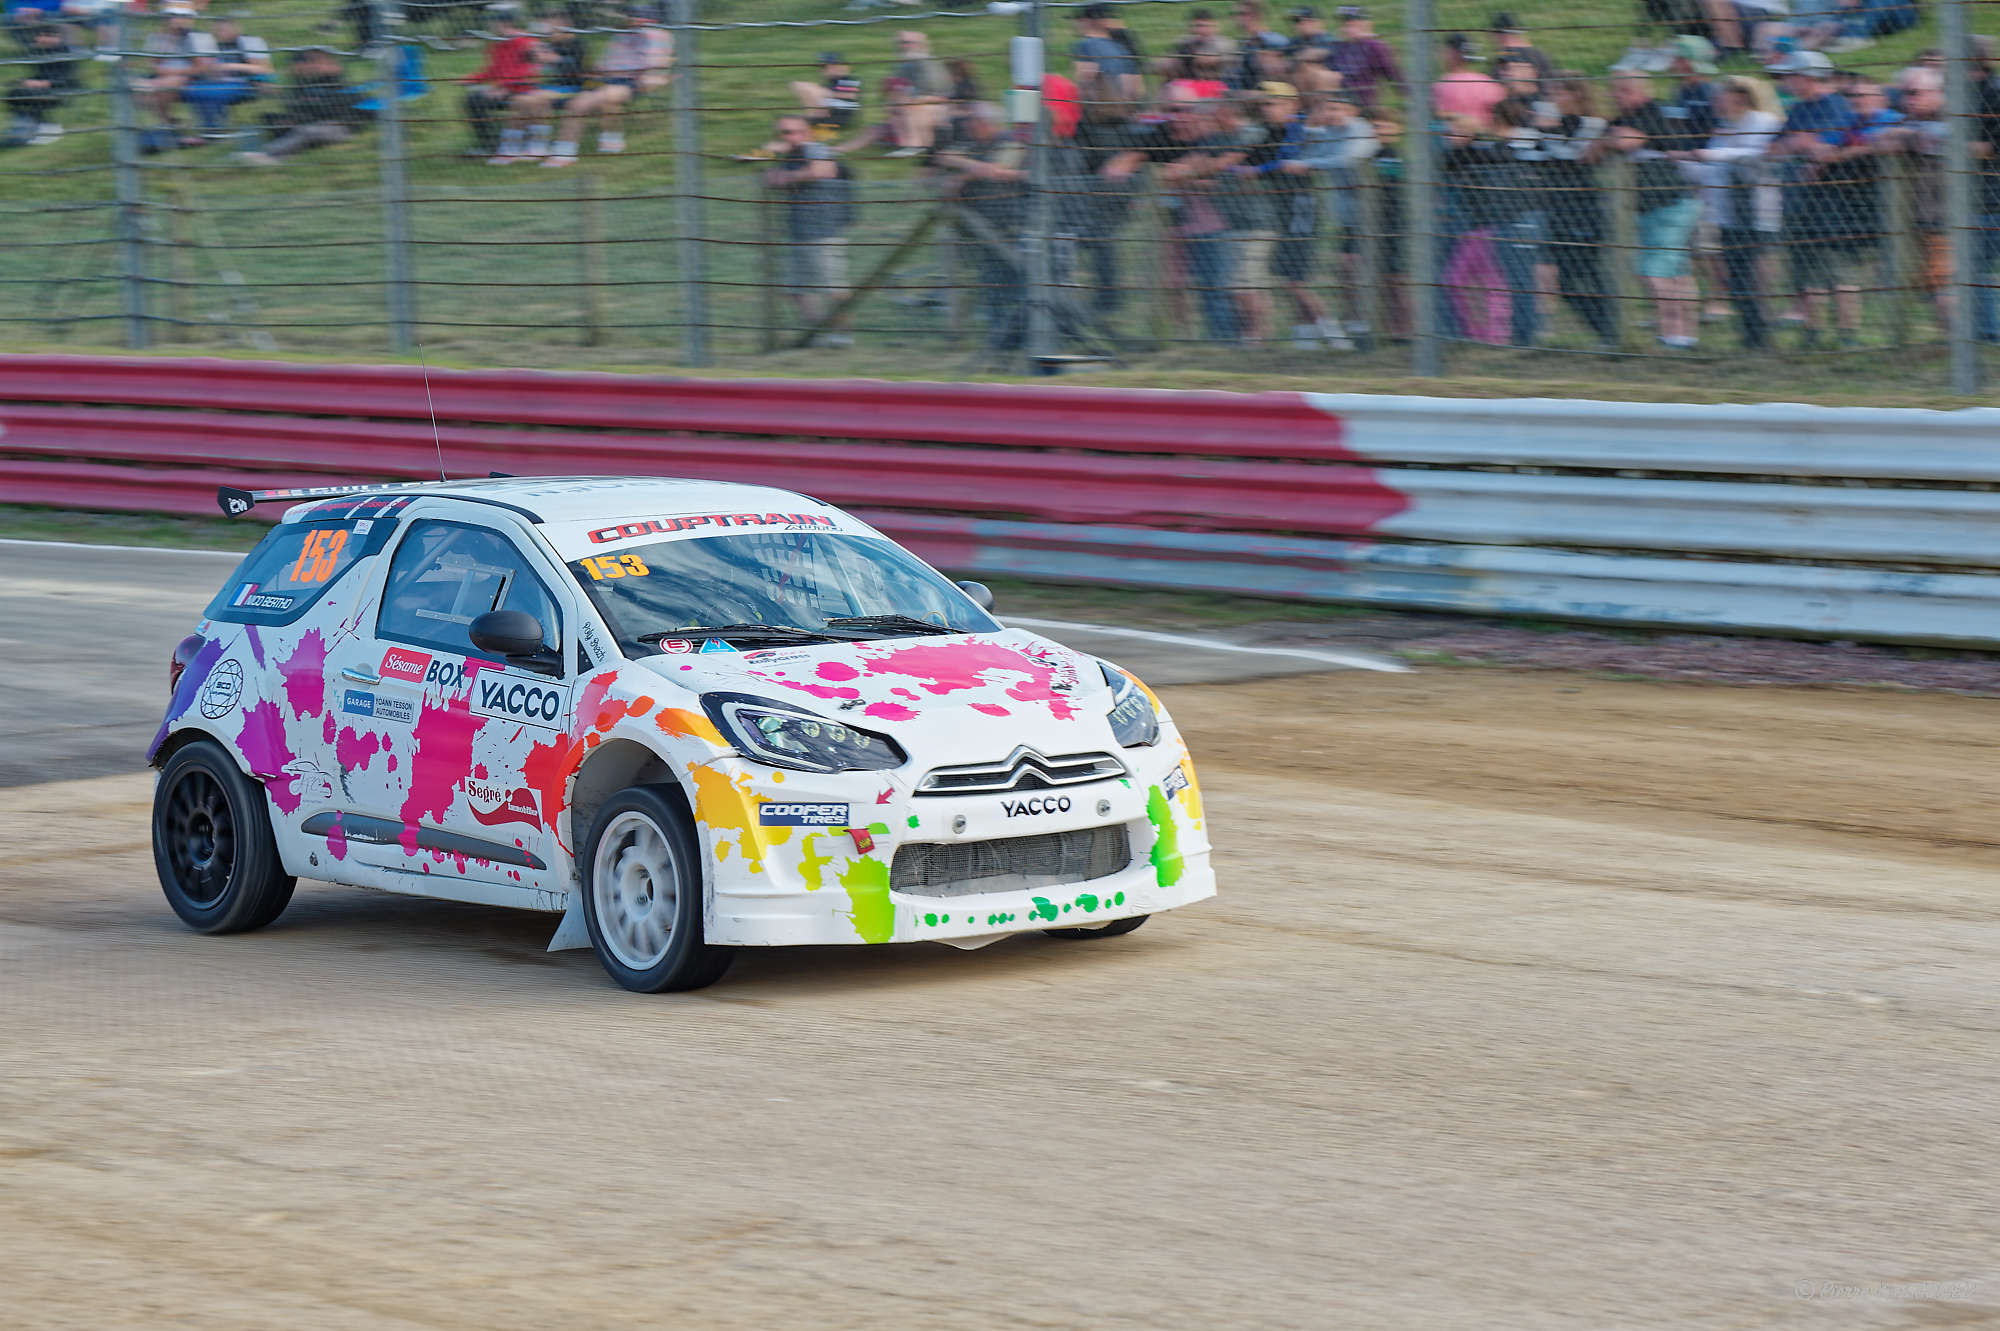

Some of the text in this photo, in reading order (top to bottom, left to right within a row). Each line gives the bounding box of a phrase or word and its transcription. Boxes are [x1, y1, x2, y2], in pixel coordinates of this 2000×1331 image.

[588, 512, 836, 544] COUPTRAIN
[290, 529, 349, 583] 153
[579, 554, 650, 581] 153
[385, 653, 424, 675] Sésame
[425, 659, 469, 689] BOX
[346, 696, 373, 709] GARAGE
[375, 697, 413, 711] YOANN TESSON
[481, 679, 560, 721] YACCO
[375, 707, 411, 720] AUTOMOBILES
[467, 780, 502, 803] Segré
[760, 804, 848, 816] COOPER
[1000, 794, 1071, 818] YACCO
[801, 815, 848, 824] TIRES
